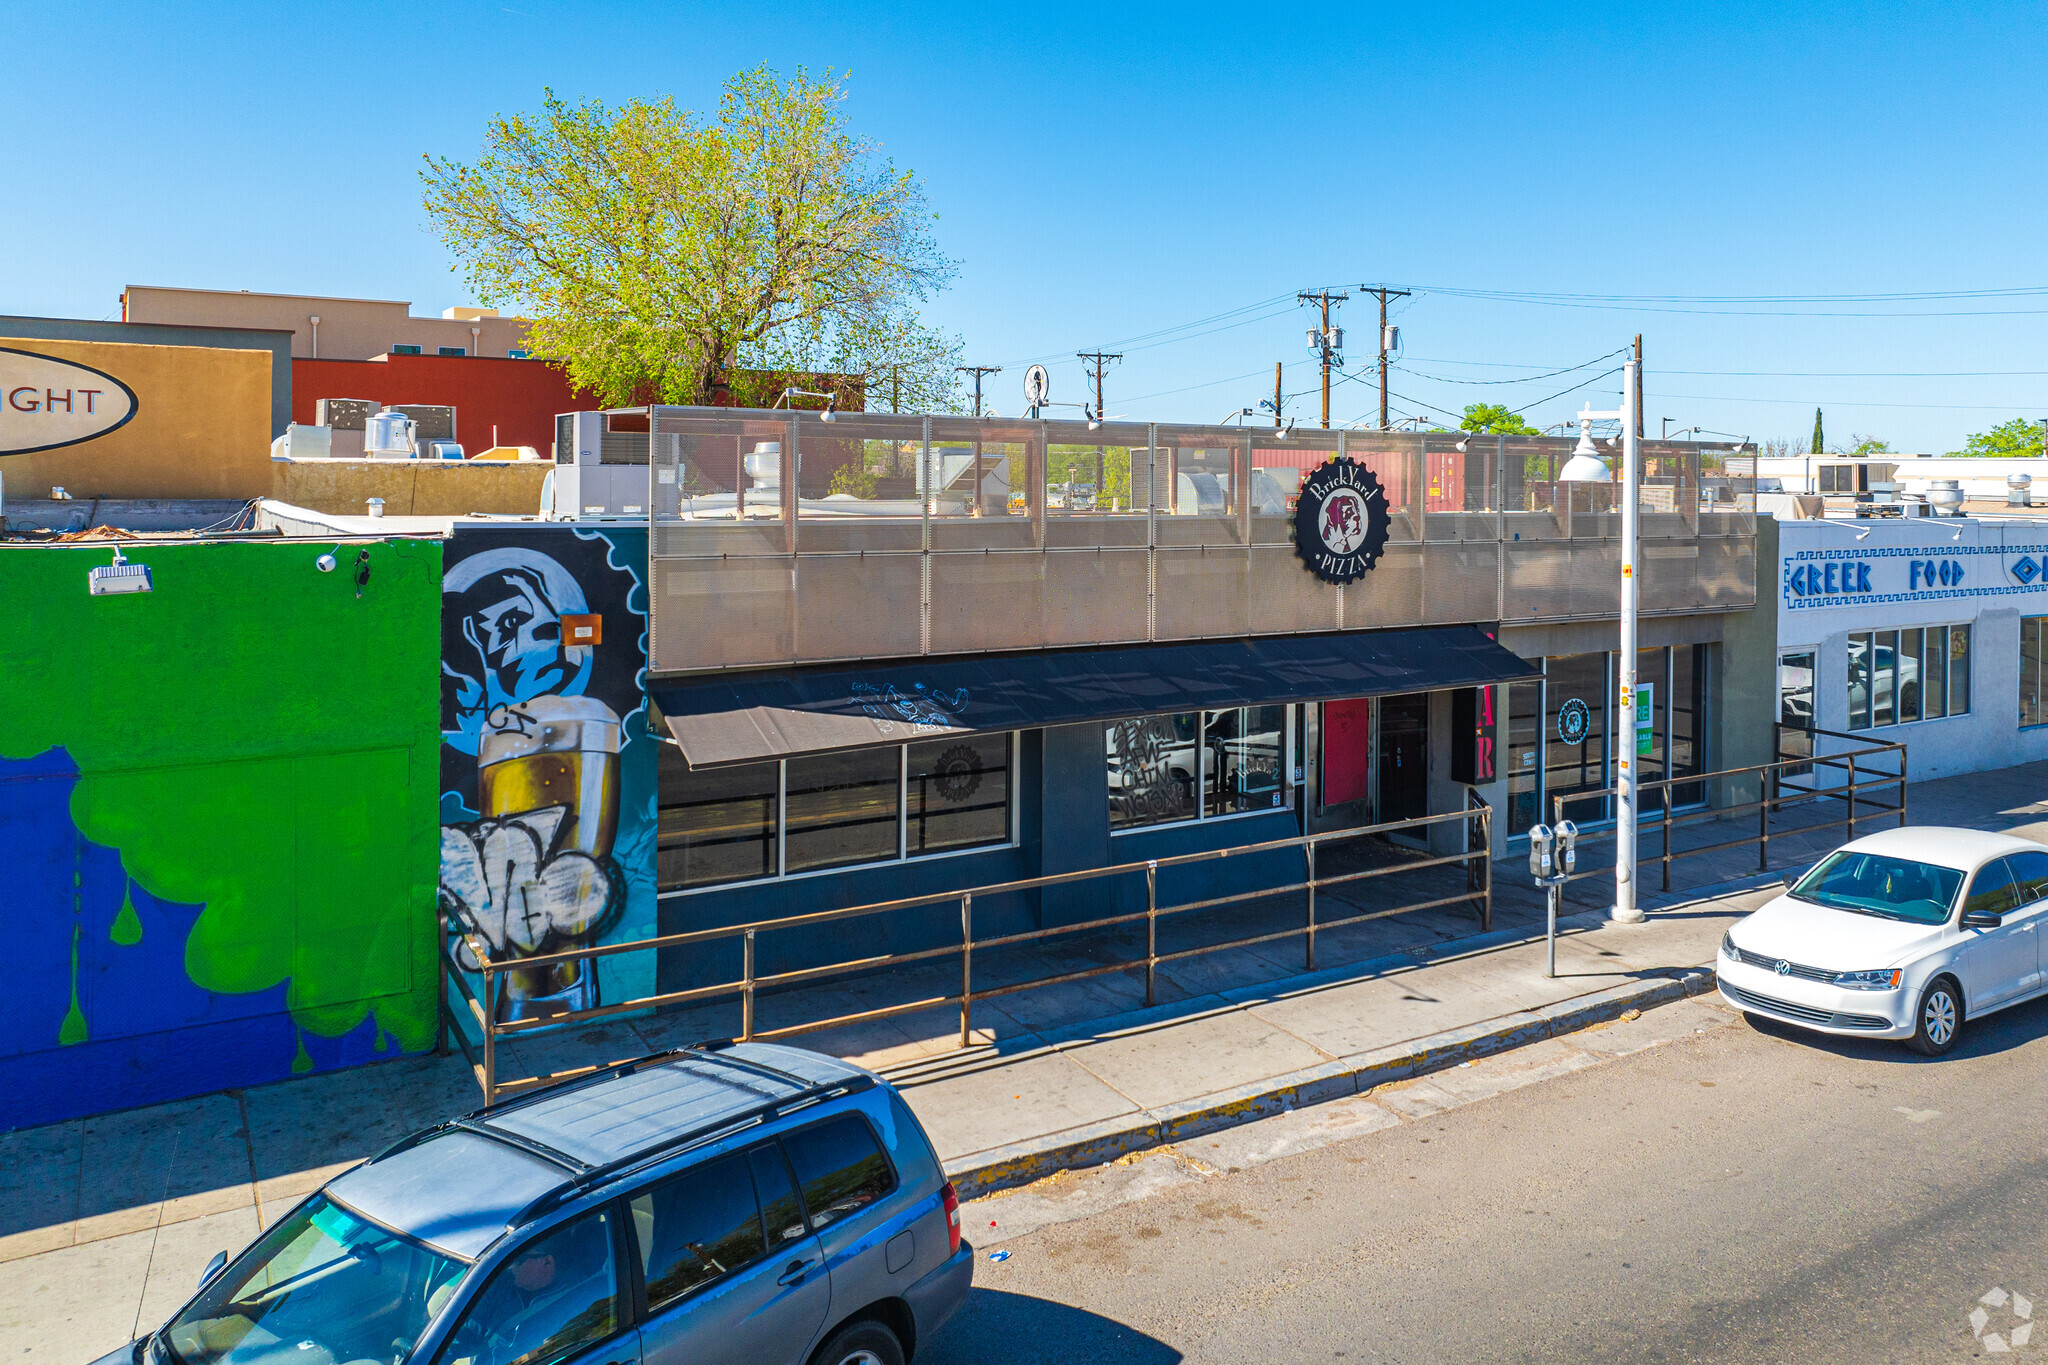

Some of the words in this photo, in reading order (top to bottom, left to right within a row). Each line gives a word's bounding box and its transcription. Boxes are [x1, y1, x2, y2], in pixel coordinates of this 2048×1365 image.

[0, 387, 104, 415] GHT
[1321, 552, 1367, 576] PIZZA
[1790, 561, 1872, 596] GREEK
[1909, 560, 1965, 590] FOOD
